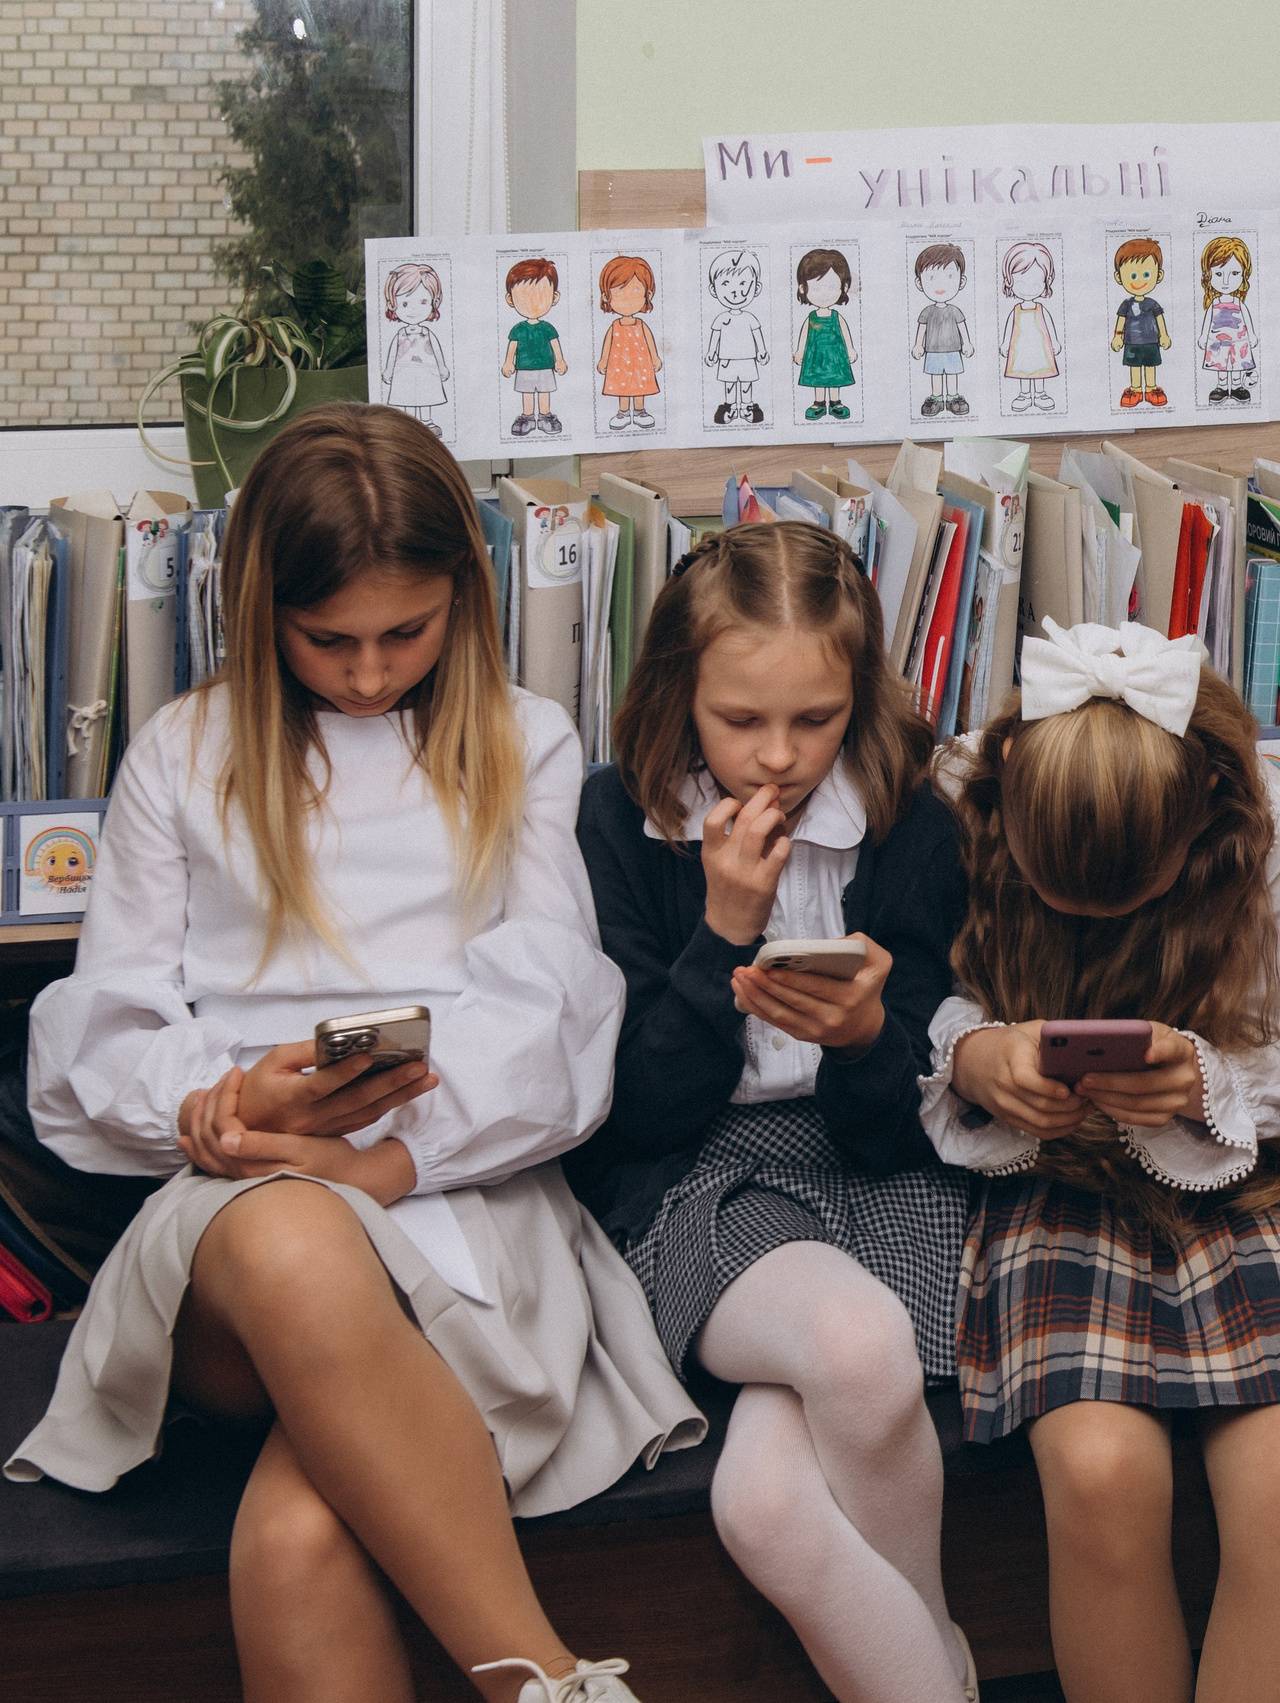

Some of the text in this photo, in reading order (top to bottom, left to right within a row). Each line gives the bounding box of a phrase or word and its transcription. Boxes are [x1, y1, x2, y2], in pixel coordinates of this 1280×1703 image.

[717, 139, 790, 181] Ми
[858, 145, 1173, 210] унікальні
[1012, 532, 1022, 553] 21
[558, 542, 578, 567] 16
[166, 557, 175, 578] 5
